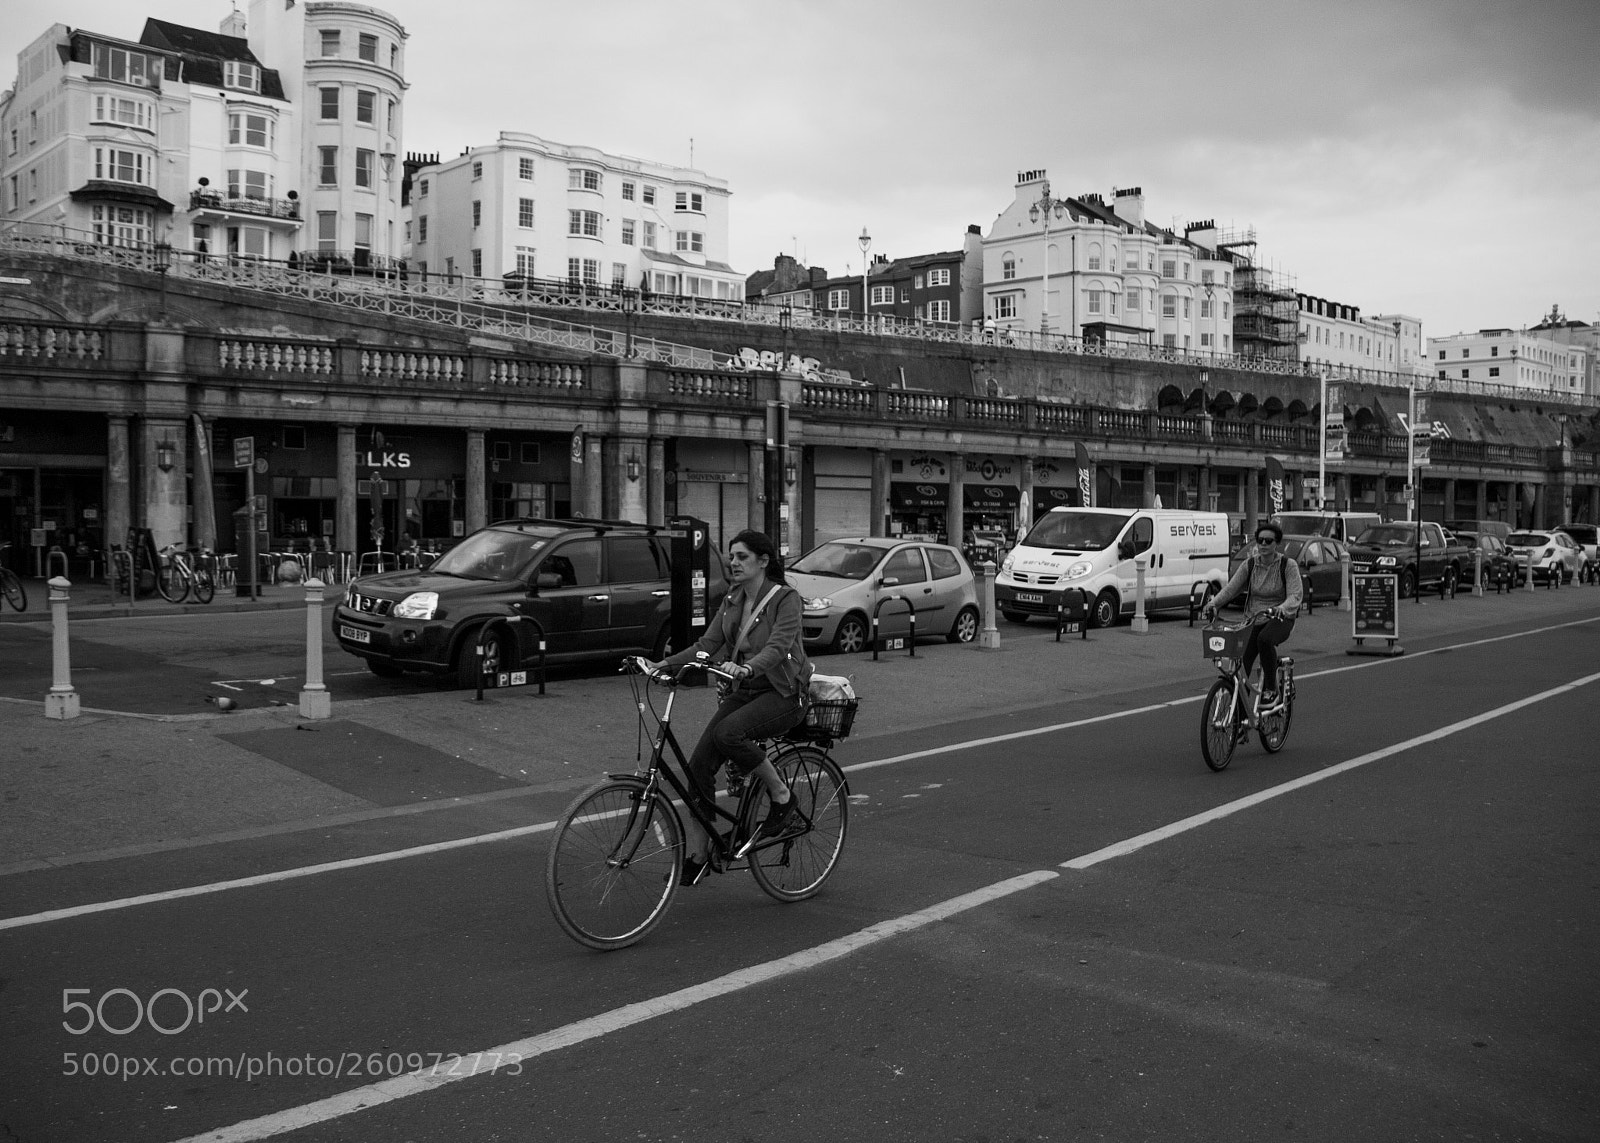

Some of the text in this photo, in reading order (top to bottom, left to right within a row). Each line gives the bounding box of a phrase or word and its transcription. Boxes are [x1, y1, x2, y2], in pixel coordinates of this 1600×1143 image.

[686, 473, 727, 481] SOUVENIRS
[1170, 521, 1217, 537] servest
[694, 530, 703, 546] P
[887, 640, 894, 650] P
[499, 673, 508, 687] P
